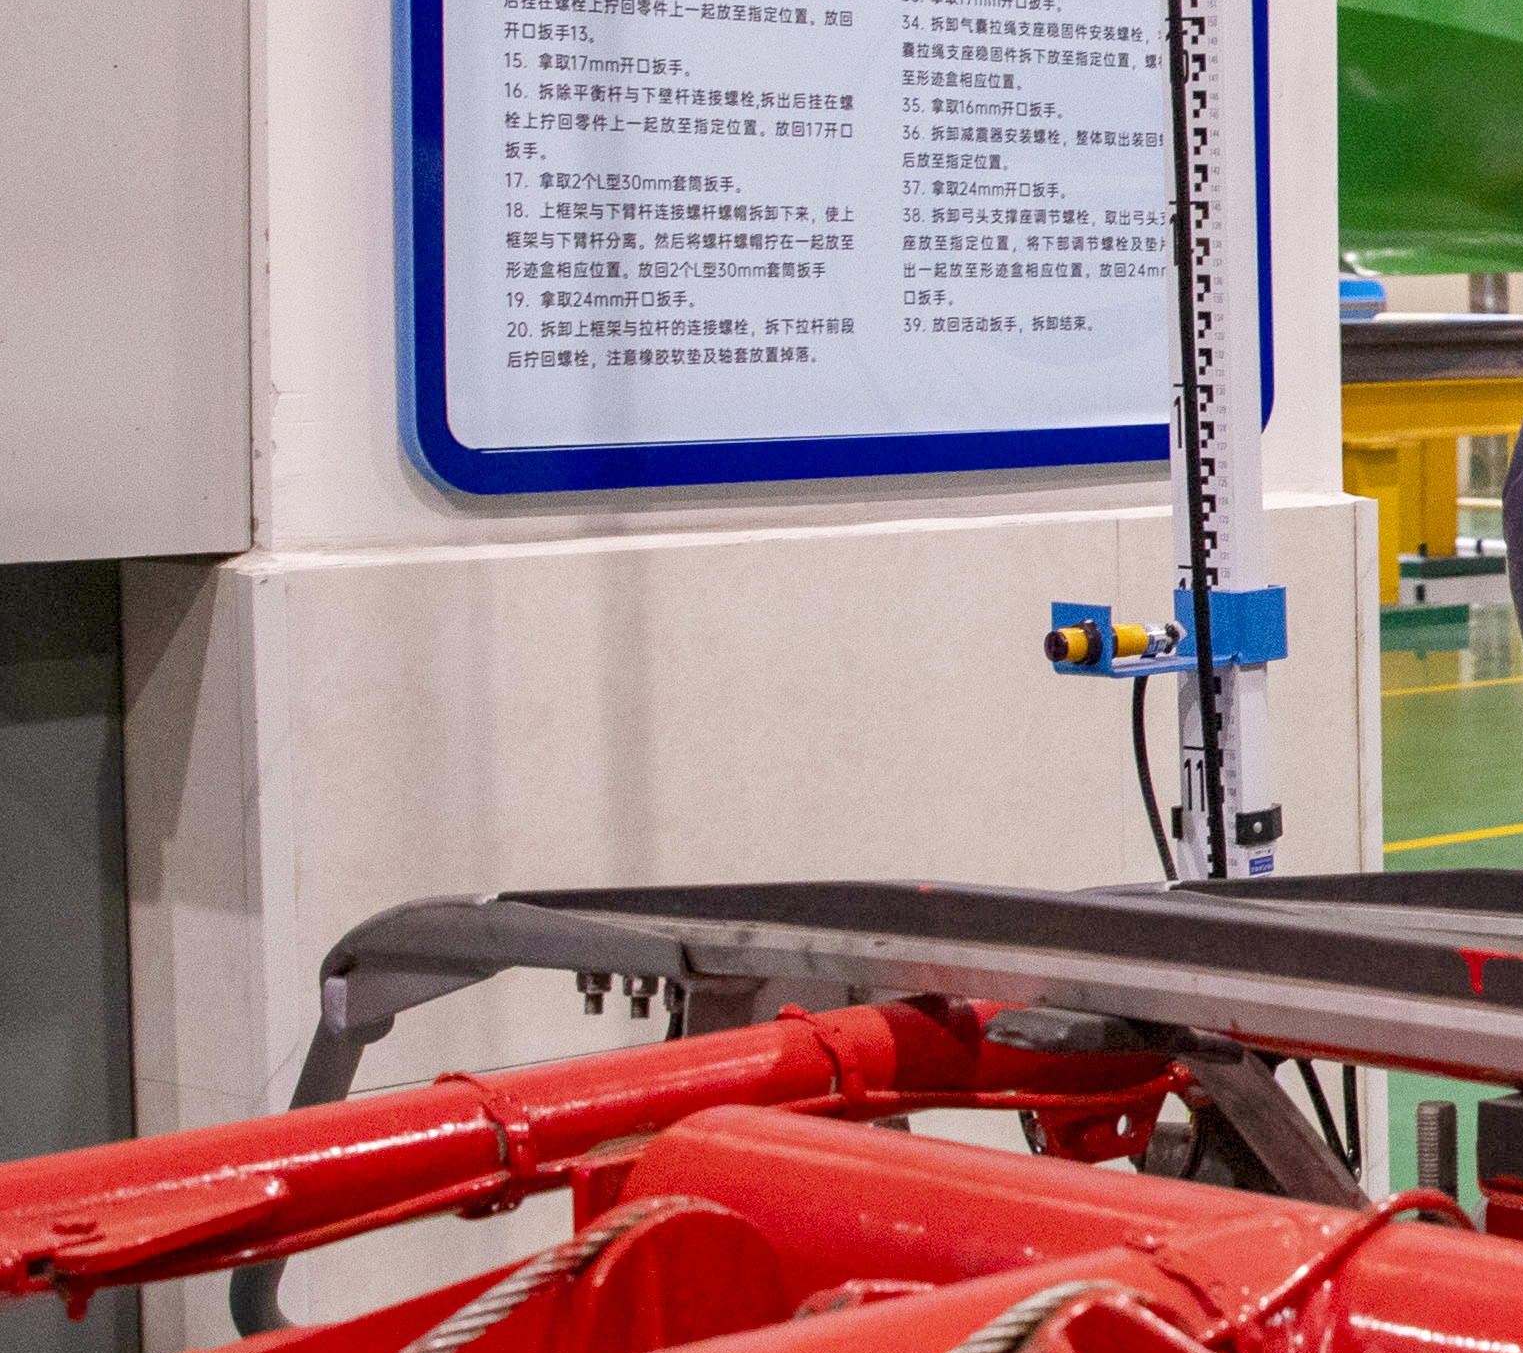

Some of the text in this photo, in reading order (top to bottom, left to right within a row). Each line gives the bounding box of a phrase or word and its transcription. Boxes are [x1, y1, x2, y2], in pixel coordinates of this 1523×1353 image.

[504, 23, 594, 43] 开口扳手13。
[902, 16, 1162, 43] 34. 拆卸气囊拉绳支座稳固件安装螺栓，
[504, 53, 693, 77] 15. 拿取17mm开口扳手。
[902, 70, 1022, 90] 至形迹盒相应位置。
[504, 83, 527, 98] 16.
[902, 98, 1063, 119] 35. 拿取16mm开口扳手。
[902, 126, 922, 141] 36.
[505, 142, 546, 160] 扳手。
[902, 153, 1008, 171] 后放至指定位置。
[506, 173, 528, 188] 17.
[903, 181, 1065, 199] 37. 拿取24mm开口扳手。
[506, 202, 528, 219] 18.
[903, 209, 923, 223] 38.
[507, 291, 695, 308] 19. 拿取24mm开口扳手。
[904, 290, 954, 306] 口扳手。
[507, 322, 532, 338] 20.
[904, 318, 925, 333] 39.
[1183, 758, 1205, 812] 11
